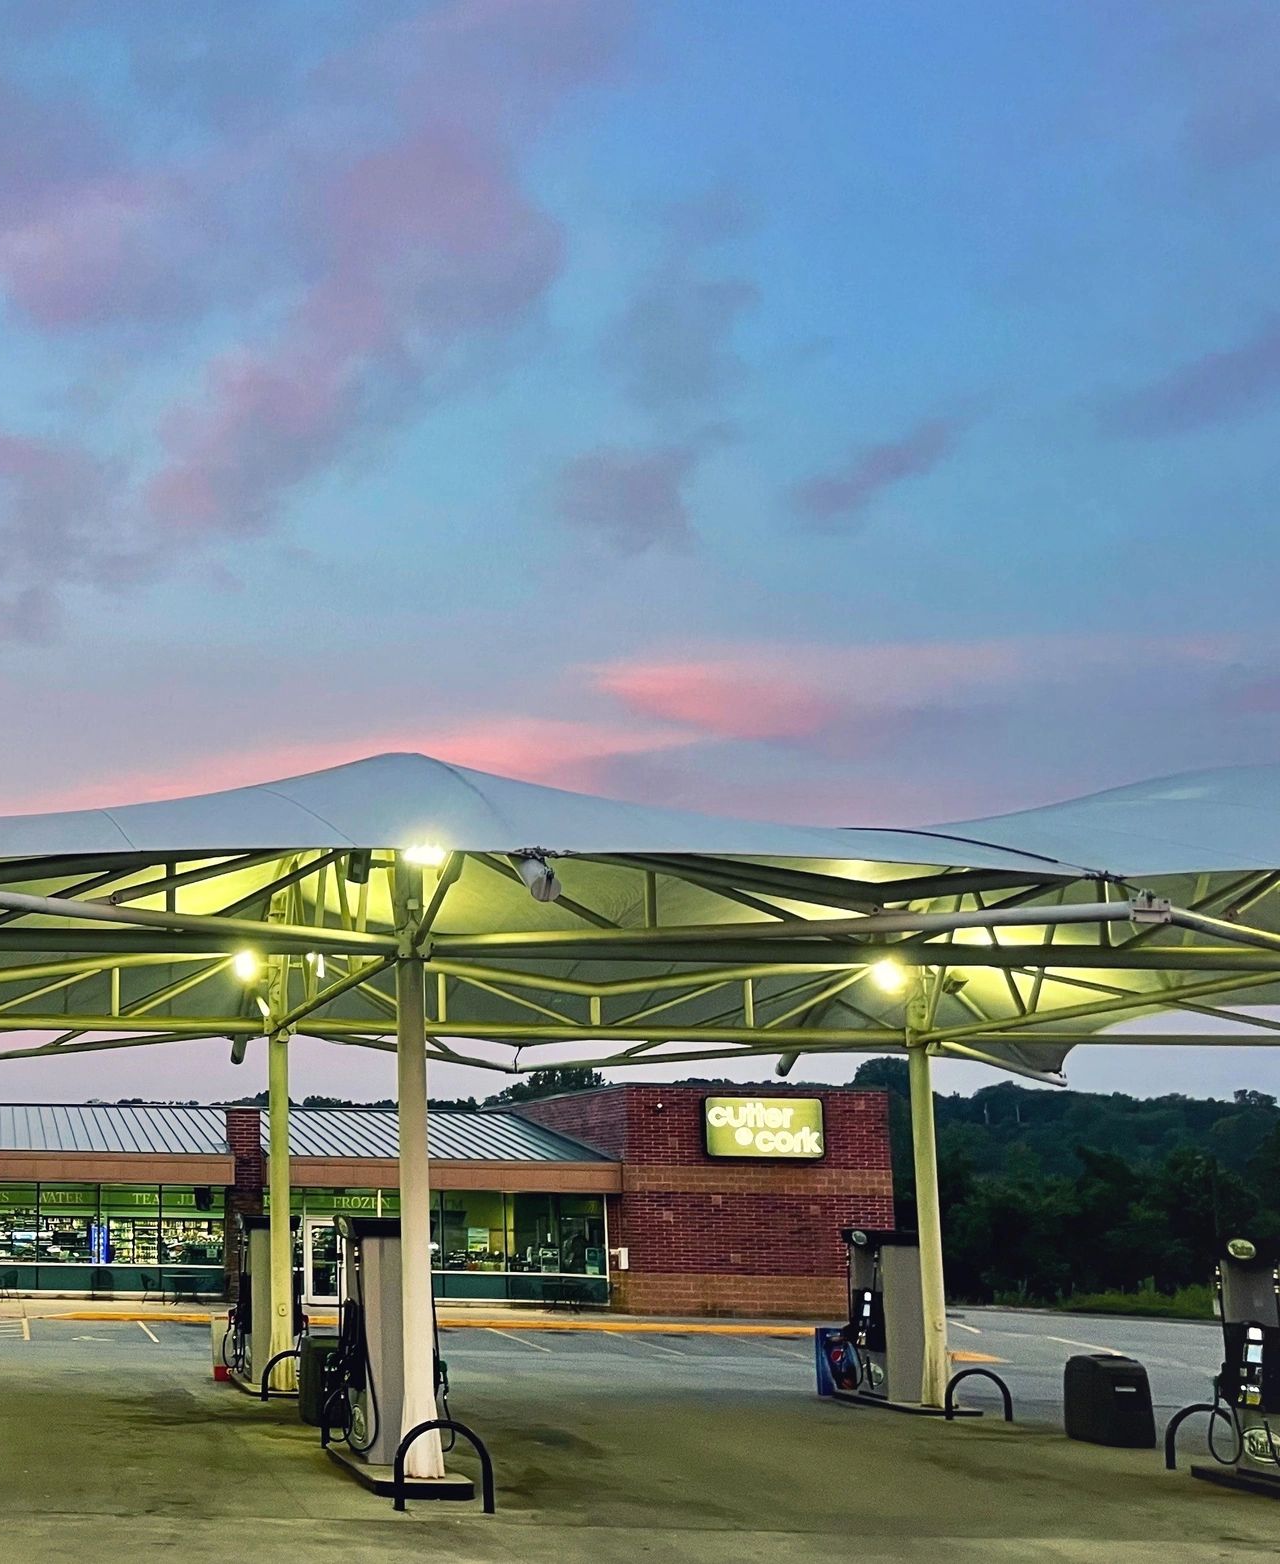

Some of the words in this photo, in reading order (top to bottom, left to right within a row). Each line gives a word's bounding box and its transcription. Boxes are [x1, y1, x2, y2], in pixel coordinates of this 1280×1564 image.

[708, 1102, 794, 1128] cutter
[755, 1126, 822, 1153] cork
[132, 1193, 160, 1205] TEA
